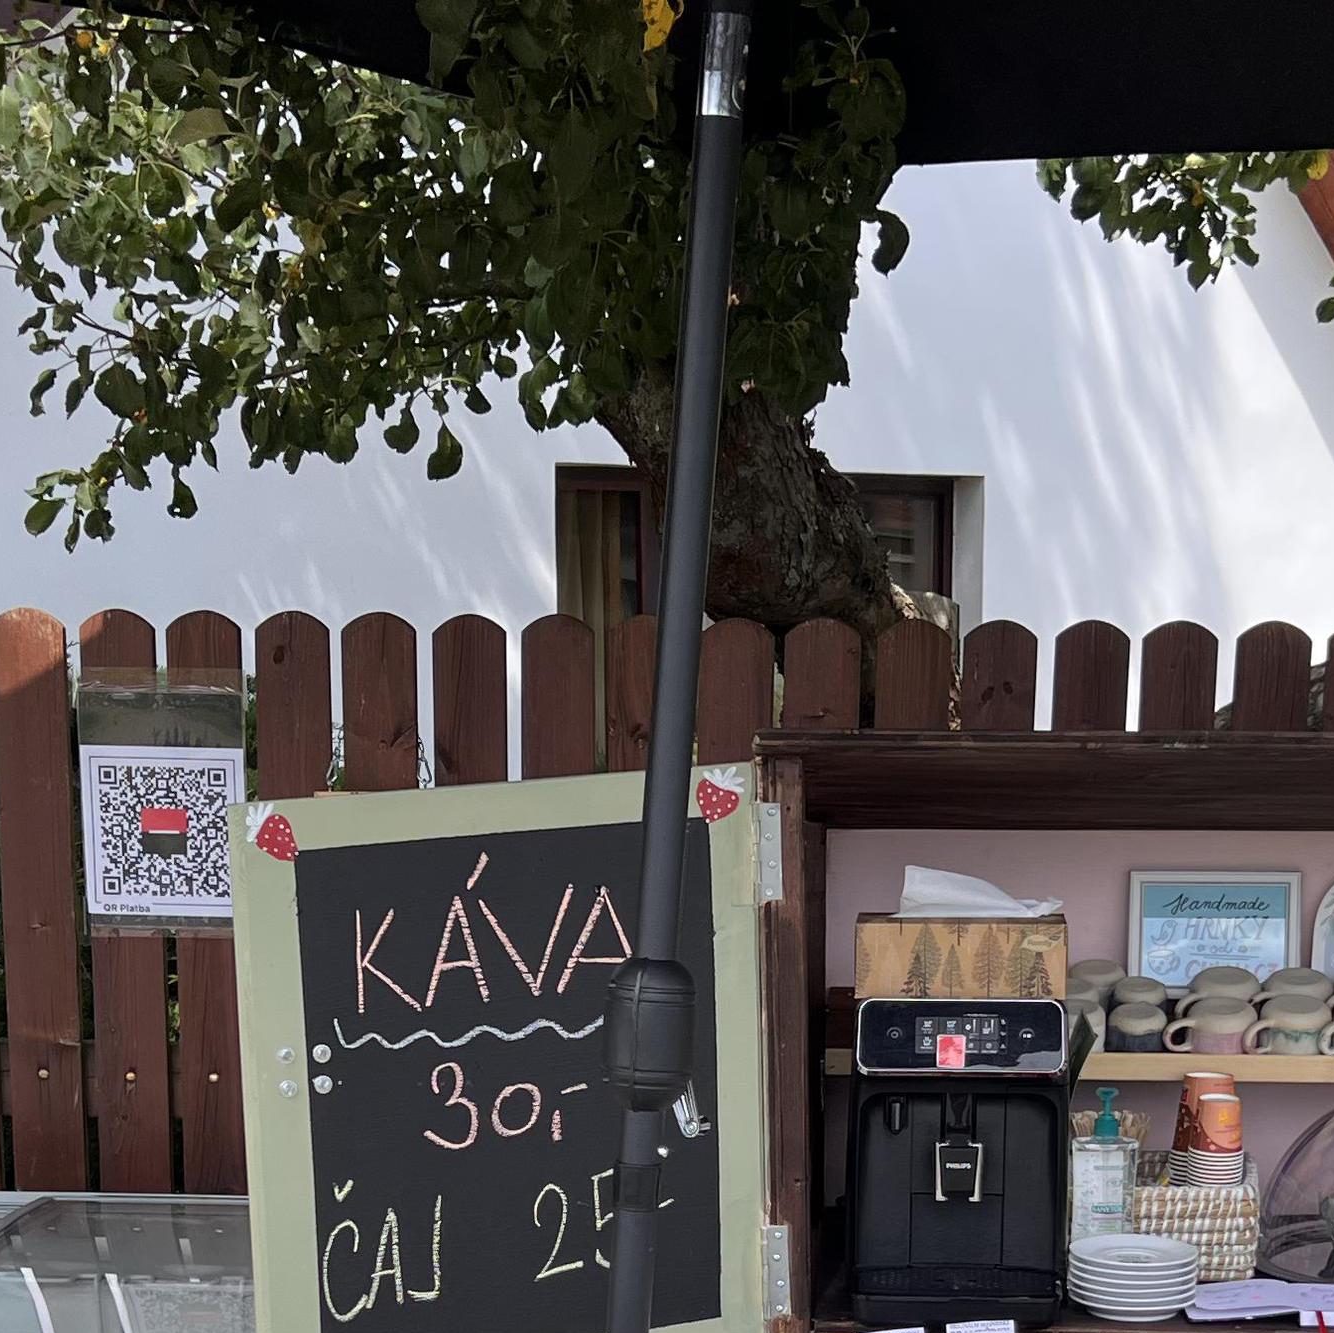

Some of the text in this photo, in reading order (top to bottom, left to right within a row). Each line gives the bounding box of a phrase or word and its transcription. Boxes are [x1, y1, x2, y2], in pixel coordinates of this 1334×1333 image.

[103, 903, 150, 912] QR Platba
[355, 852, 634, 1013] KÁVA
[1163, 893, 1270, 915] Handmade
[423, 1061, 589, 1151] 30,-
[322, 1179, 442, 1323] ČAJ
